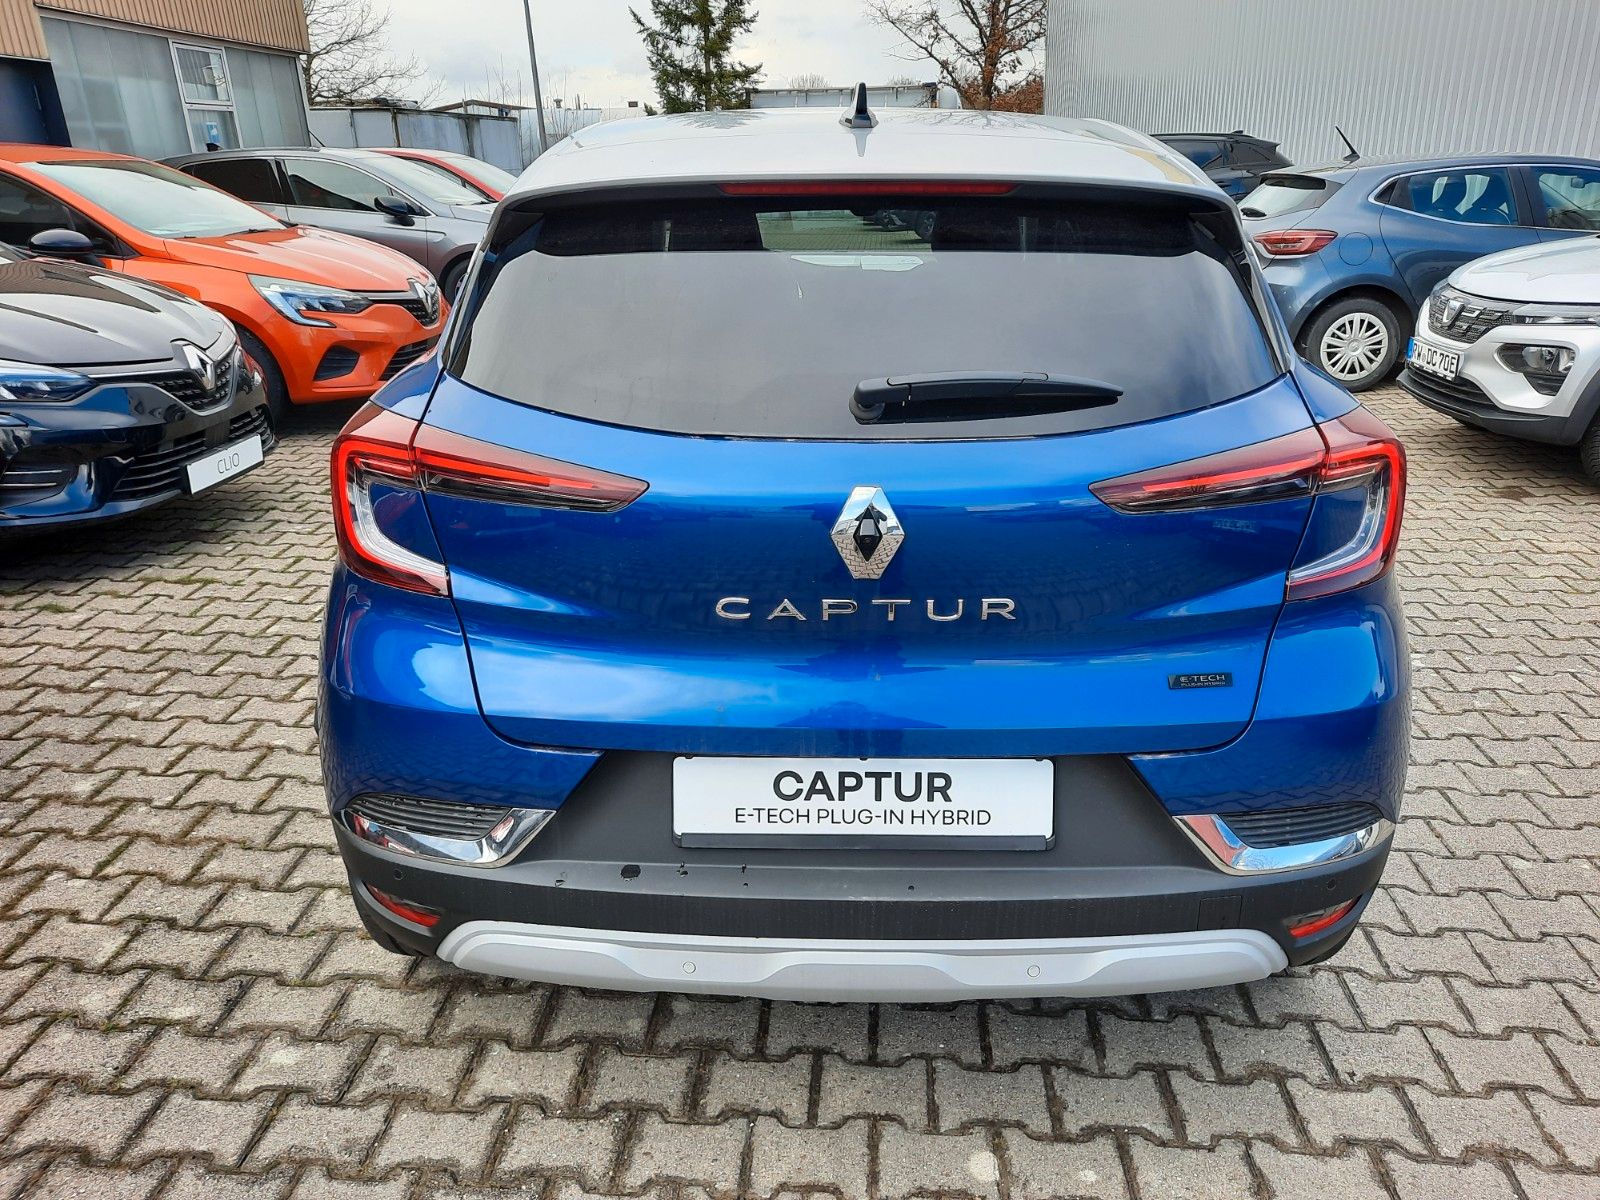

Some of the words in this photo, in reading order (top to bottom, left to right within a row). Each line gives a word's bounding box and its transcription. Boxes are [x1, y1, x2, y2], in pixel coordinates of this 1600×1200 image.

[1426, 348, 1437, 366] DC
[1439, 352, 1456, 374] 70E
[217, 453, 239, 473] CLIO
[715, 597, 1017, 622] CAPTUR
[1180, 674, 1225, 682] E-TECH
[773, 770, 953, 802] CAPTUR
[735, 808, 810, 824] E-TECH
[817, 809, 904, 825] PLUG-IN
[911, 809, 992, 825] HYBRID
